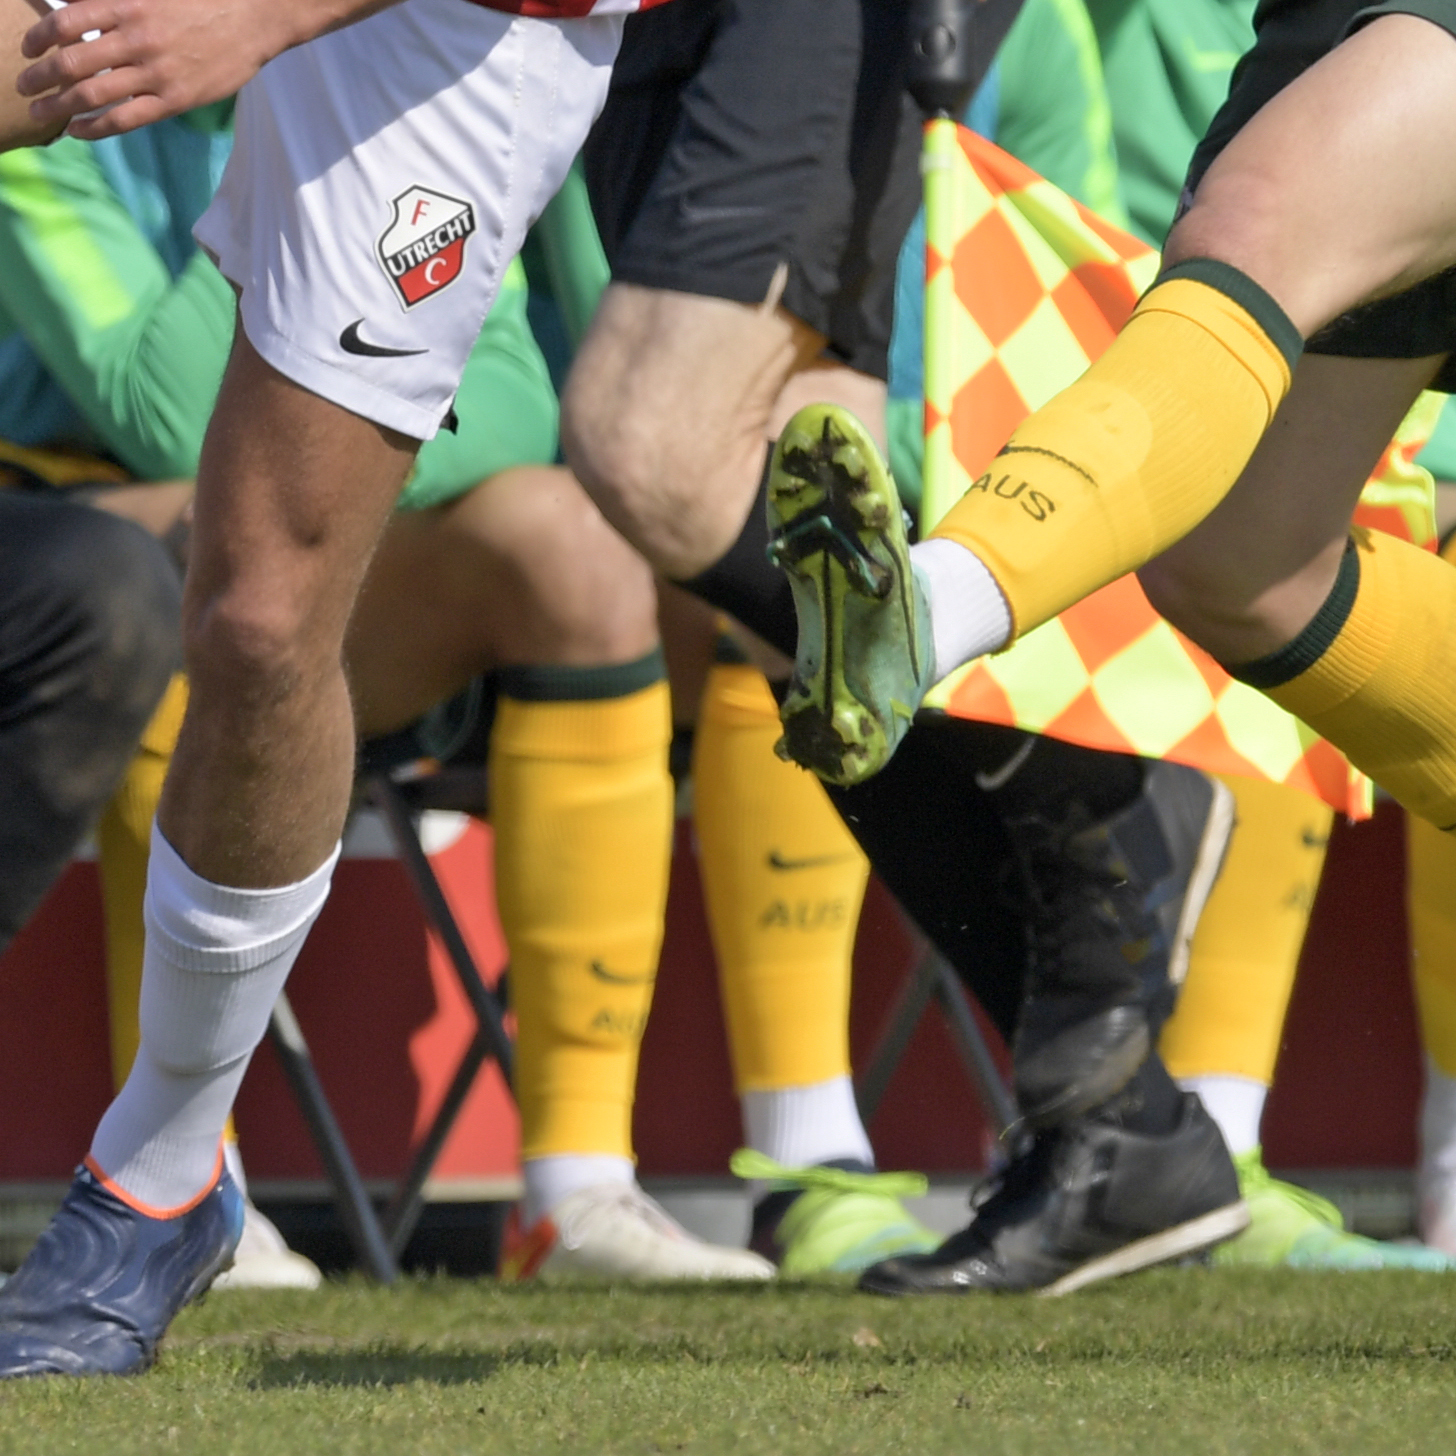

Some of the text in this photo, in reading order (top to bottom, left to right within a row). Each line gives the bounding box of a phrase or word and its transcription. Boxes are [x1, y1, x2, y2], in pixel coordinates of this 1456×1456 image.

[410, 198, 431, 226] F
[386, 210, 472, 277] UTRECHT
[424, 256, 447, 285] C
[964, 472, 1057, 522] AUS
